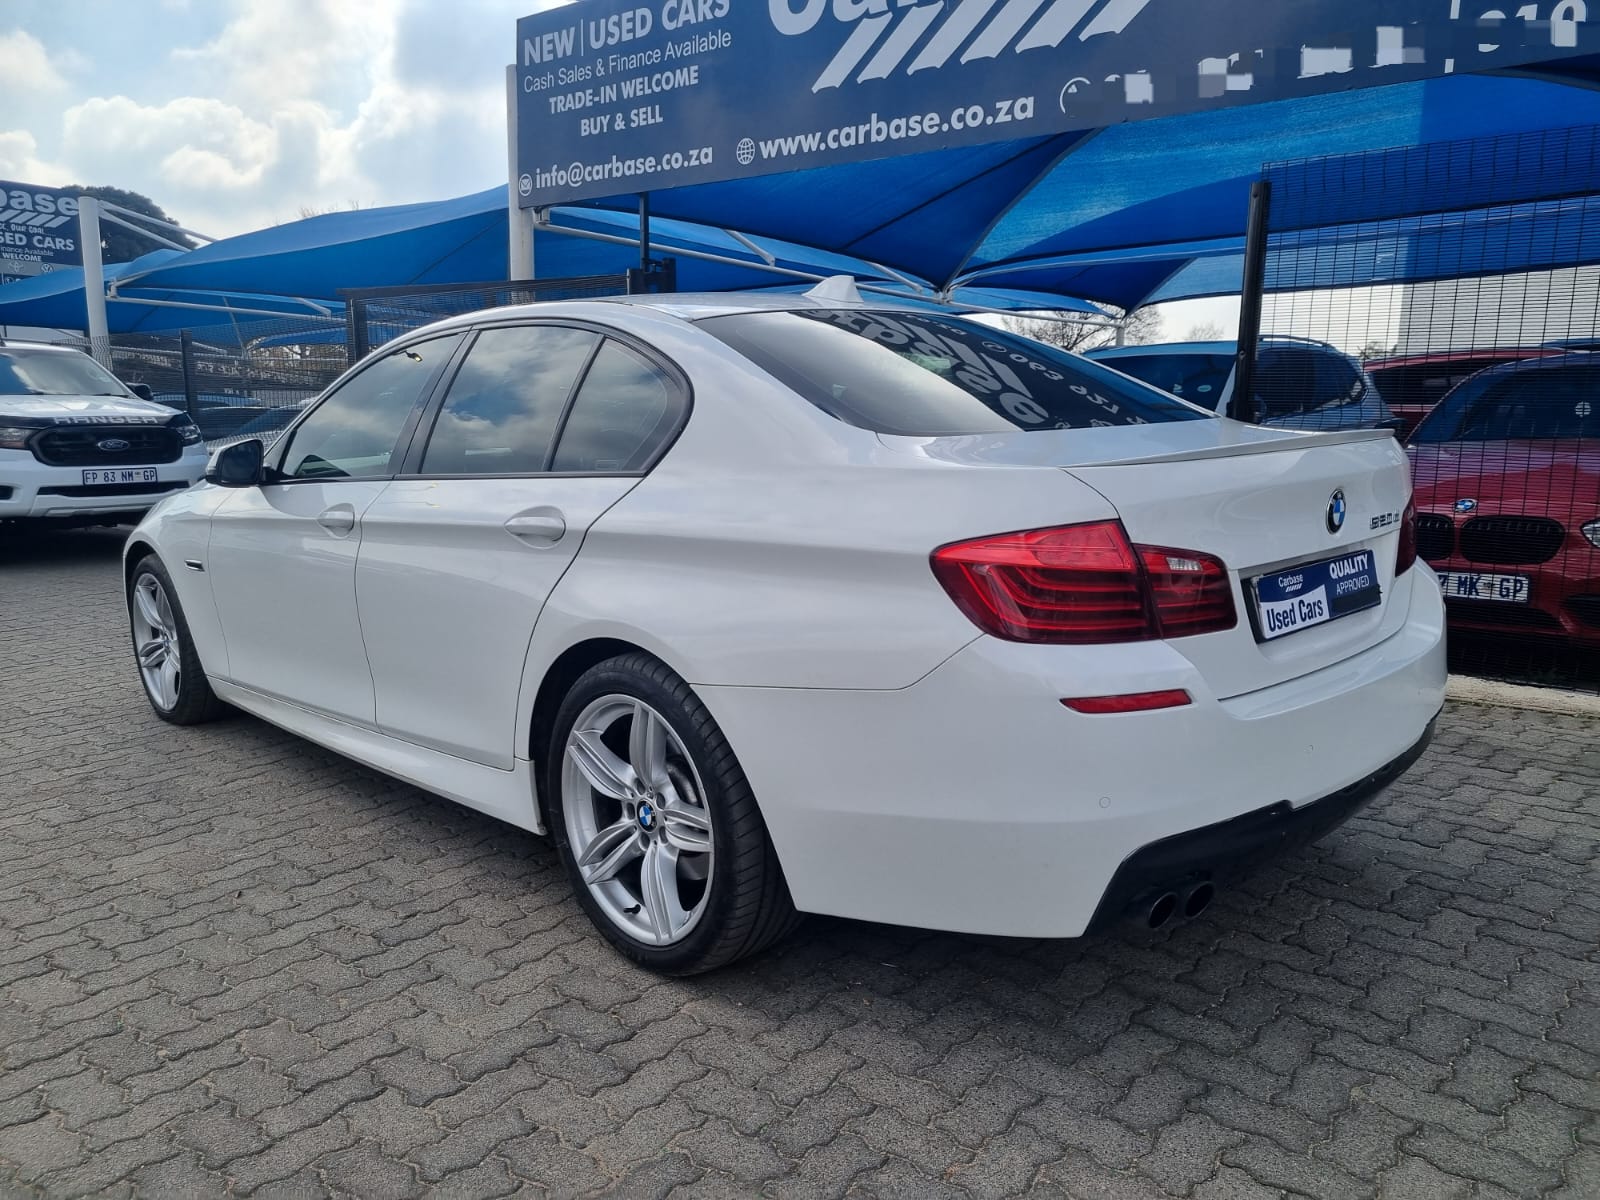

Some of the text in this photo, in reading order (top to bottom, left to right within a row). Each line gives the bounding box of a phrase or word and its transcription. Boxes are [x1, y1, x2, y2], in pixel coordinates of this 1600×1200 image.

[524, 26, 575, 66] NEW
[590, 8, 652, 50] USED
[661, 0, 730, 31] CARS
[524, 29, 732, 93] Cash Sales & Finance Available
[549, 65, 699, 114] TRADE-IN WELCOME
[580, 104, 664, 137] BUY & SELL
[759, 95, 1035, 160] www.carbase.co.za
[535, 146, 713, 189] info@carbase.co.za
[2, 252, 42, 262] WELCOME
[32, 235, 76, 251] CARS
[85, 472, 98, 484] FP
[103, 471, 116, 483] 83
[143, 469, 155, 482] GP
[1278, 574, 1304, 588] Carbase
[1329, 553, 1368, 580] QUALITY
[1336, 574, 1370, 596] APPROVED
[1499, 577, 1523, 599] GP
[1266, 599, 1324, 633] Used Cars
